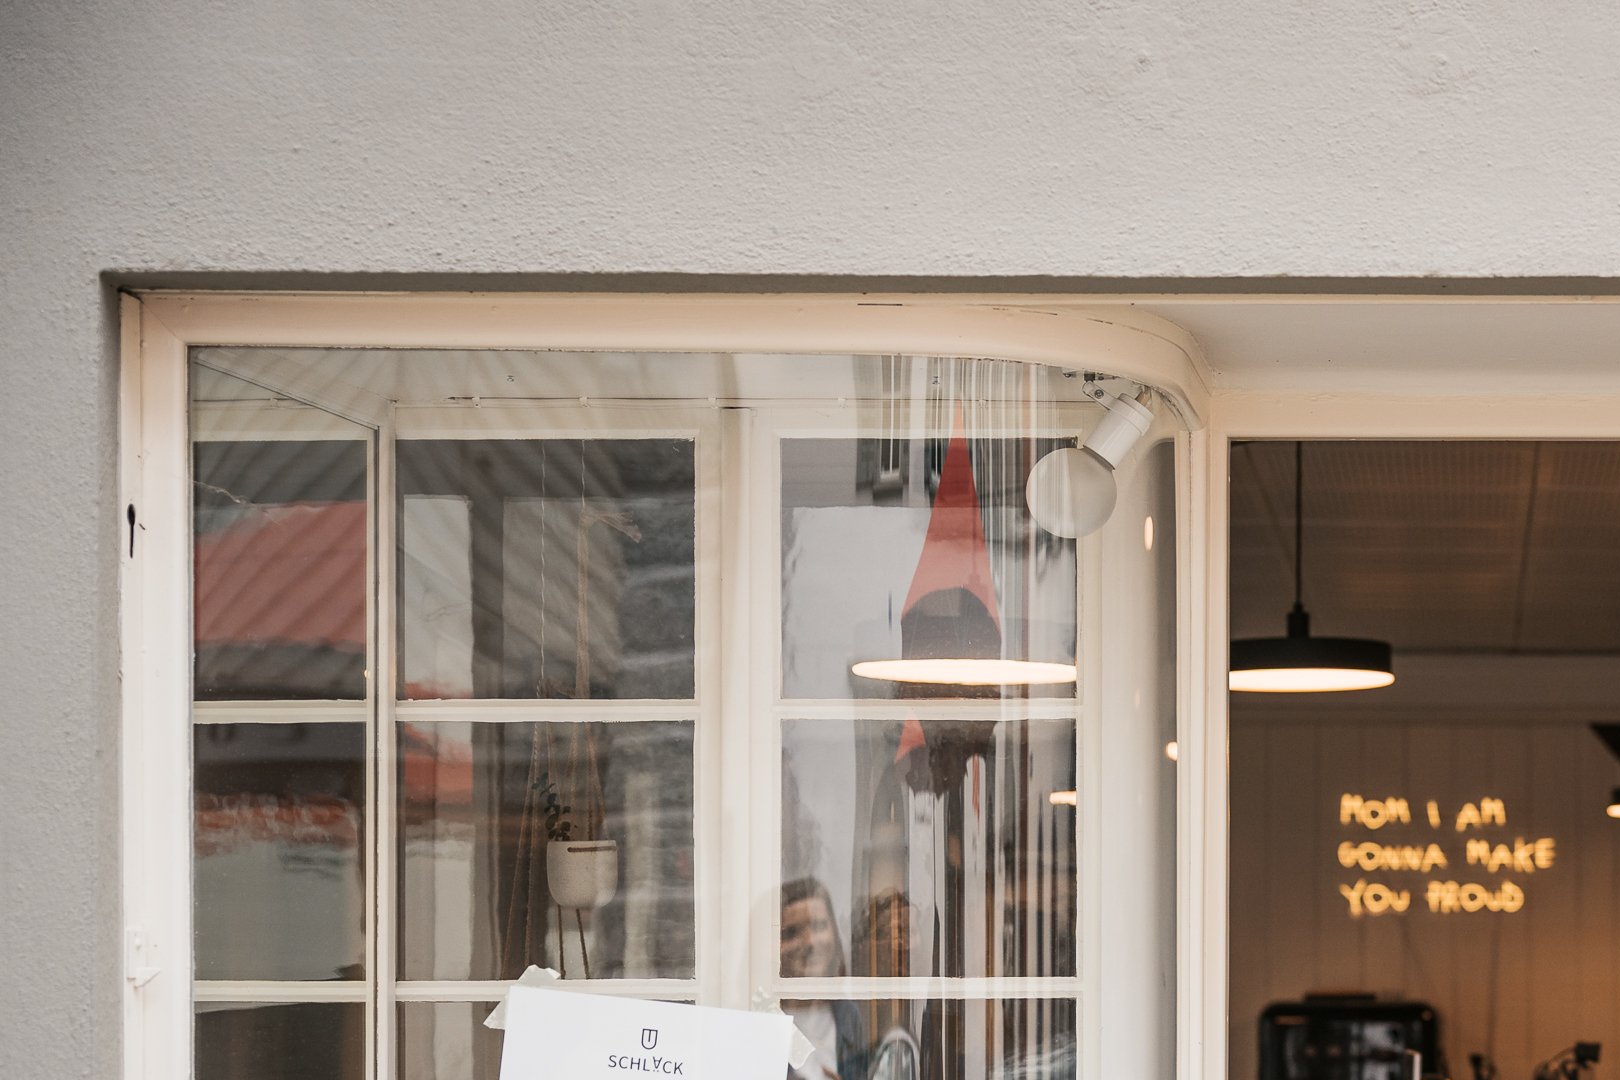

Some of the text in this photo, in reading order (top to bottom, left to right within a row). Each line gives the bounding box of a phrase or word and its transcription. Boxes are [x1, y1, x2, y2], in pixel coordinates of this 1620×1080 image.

[1339, 792, 1507, 832] MOM I AM
[1337, 836, 1557, 873] GONNA MAKE
[1338, 878, 1411, 919] YOU
